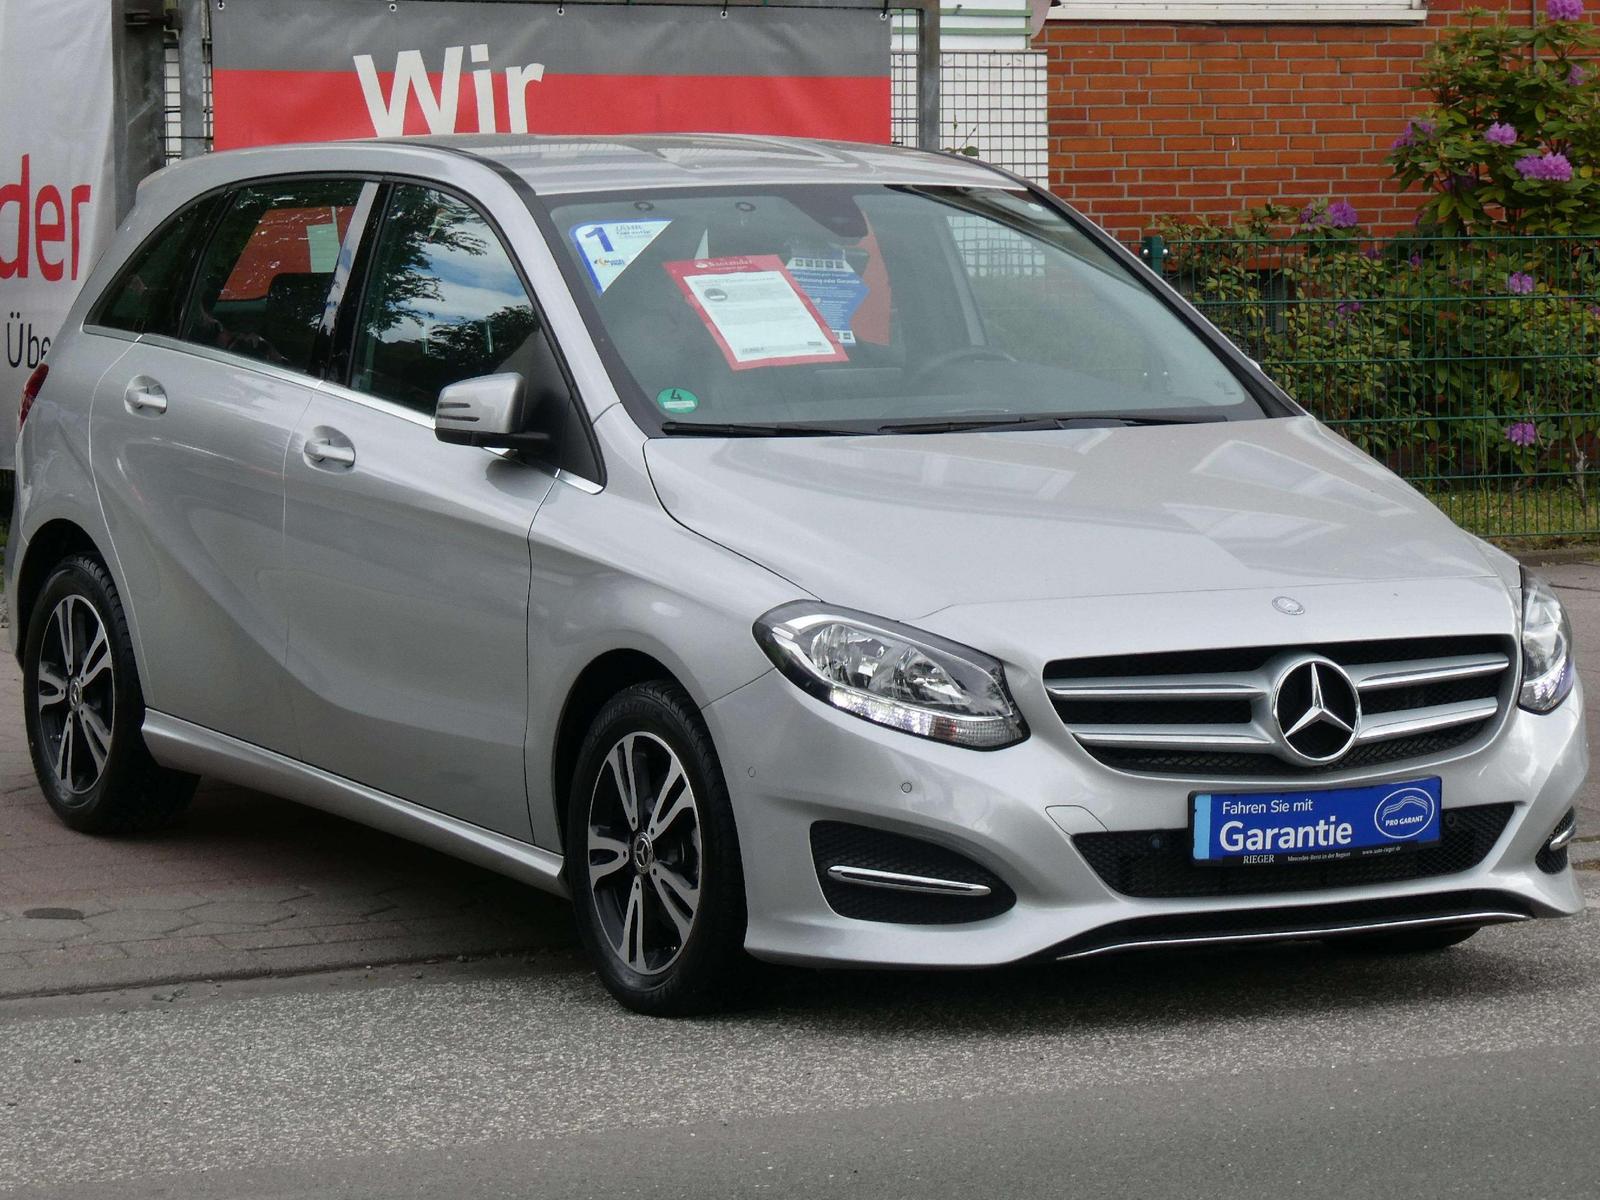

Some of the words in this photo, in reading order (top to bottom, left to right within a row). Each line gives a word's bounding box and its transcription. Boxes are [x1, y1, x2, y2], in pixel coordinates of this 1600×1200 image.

[353, 43, 545, 137] Wir
[585, 227, 614, 252] 1
[671, 388, 682, 401] 4
[1222, 800, 1266, 815] Fahren
[1270, 799, 1289, 813] Sie
[1293, 798, 1313, 812] mit
[1385, 818, 1398, 827] PRO
[1400, 815, 1424, 825] GARANT
[1219, 815, 1353, 851] Garantie
[1243, 854, 1275, 864] RIEGER
